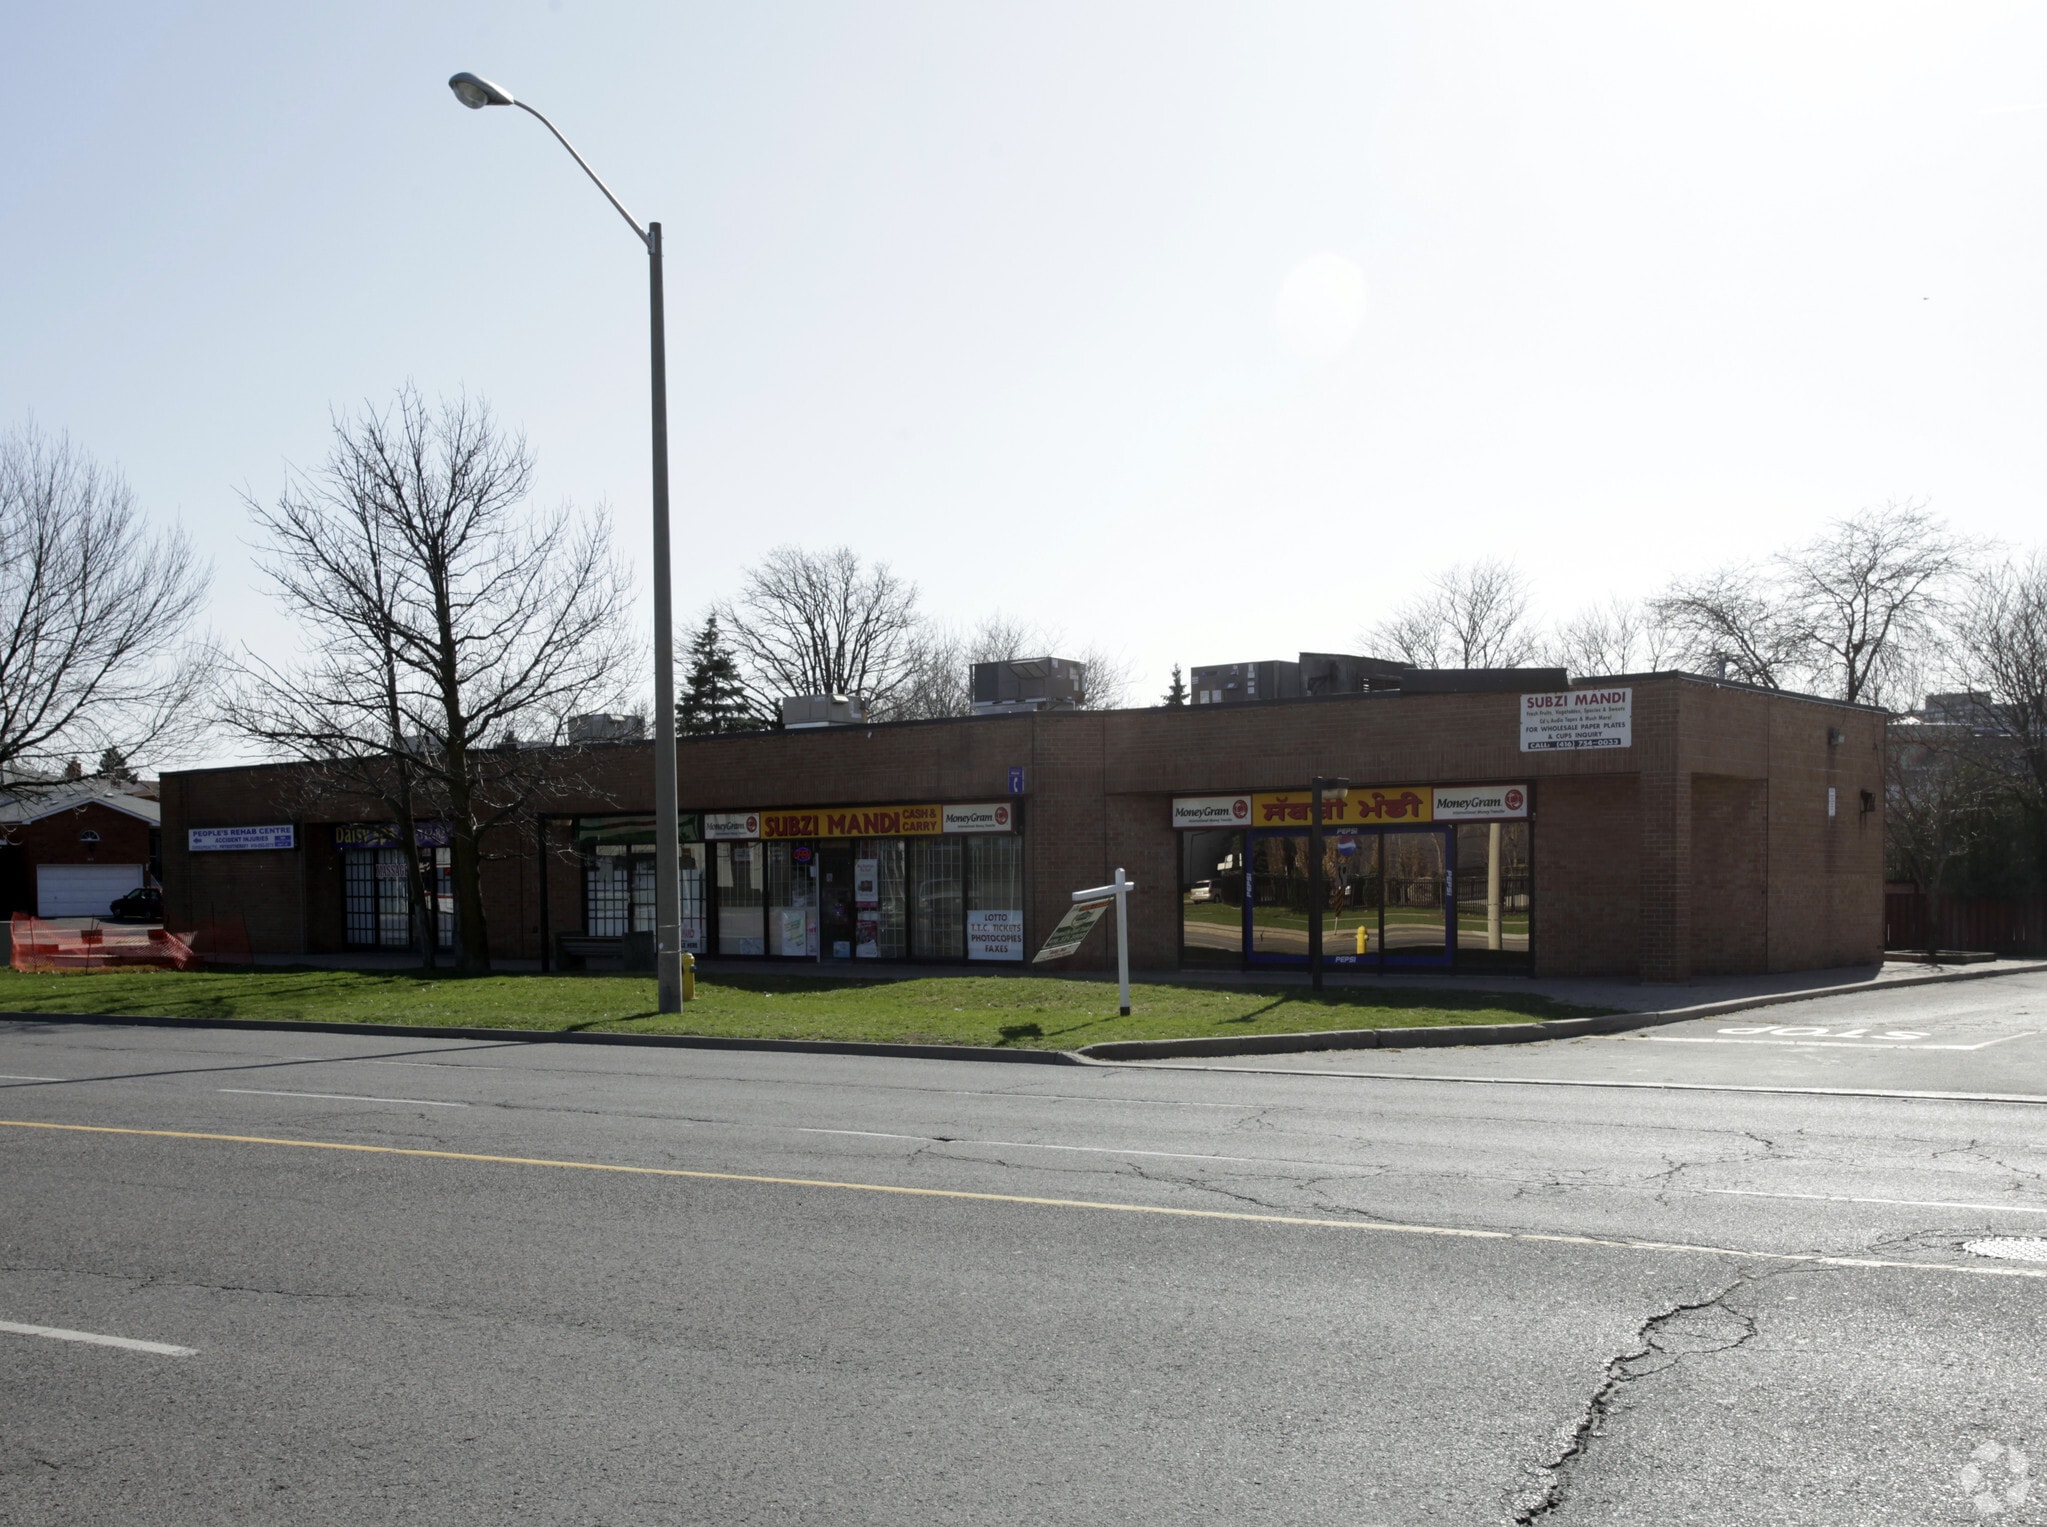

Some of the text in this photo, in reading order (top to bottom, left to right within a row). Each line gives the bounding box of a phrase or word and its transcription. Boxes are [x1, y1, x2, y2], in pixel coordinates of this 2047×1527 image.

[1527, 691, 1626, 709] SUBZI MANDI
[1541, 724, 1578, 732] WHOLESALE
[1556, 740, 1575, 748] (416)
[1437, 797, 1501, 810] MoneyGram
[902, 808, 936, 819] CASH &
[946, 812, 993, 824] MoneyGram
[1175, 806, 1229, 819] MoneyGram
[765, 811, 900, 837] SUBZI MANDI
[902, 820, 937, 832] CARRY
[193, 827, 291, 838] PEOPLE'S REHAB CENTRE
[335, 826, 369, 844] Daisy
[984, 913, 1008, 922] LOTTO
[992, 924, 1021, 932] TICKETS
[971, 934, 1022, 943] PHOTOCOPIES
[985, 945, 1008, 953] FAXES
[1717, 1025, 1932, 1040] STOP
